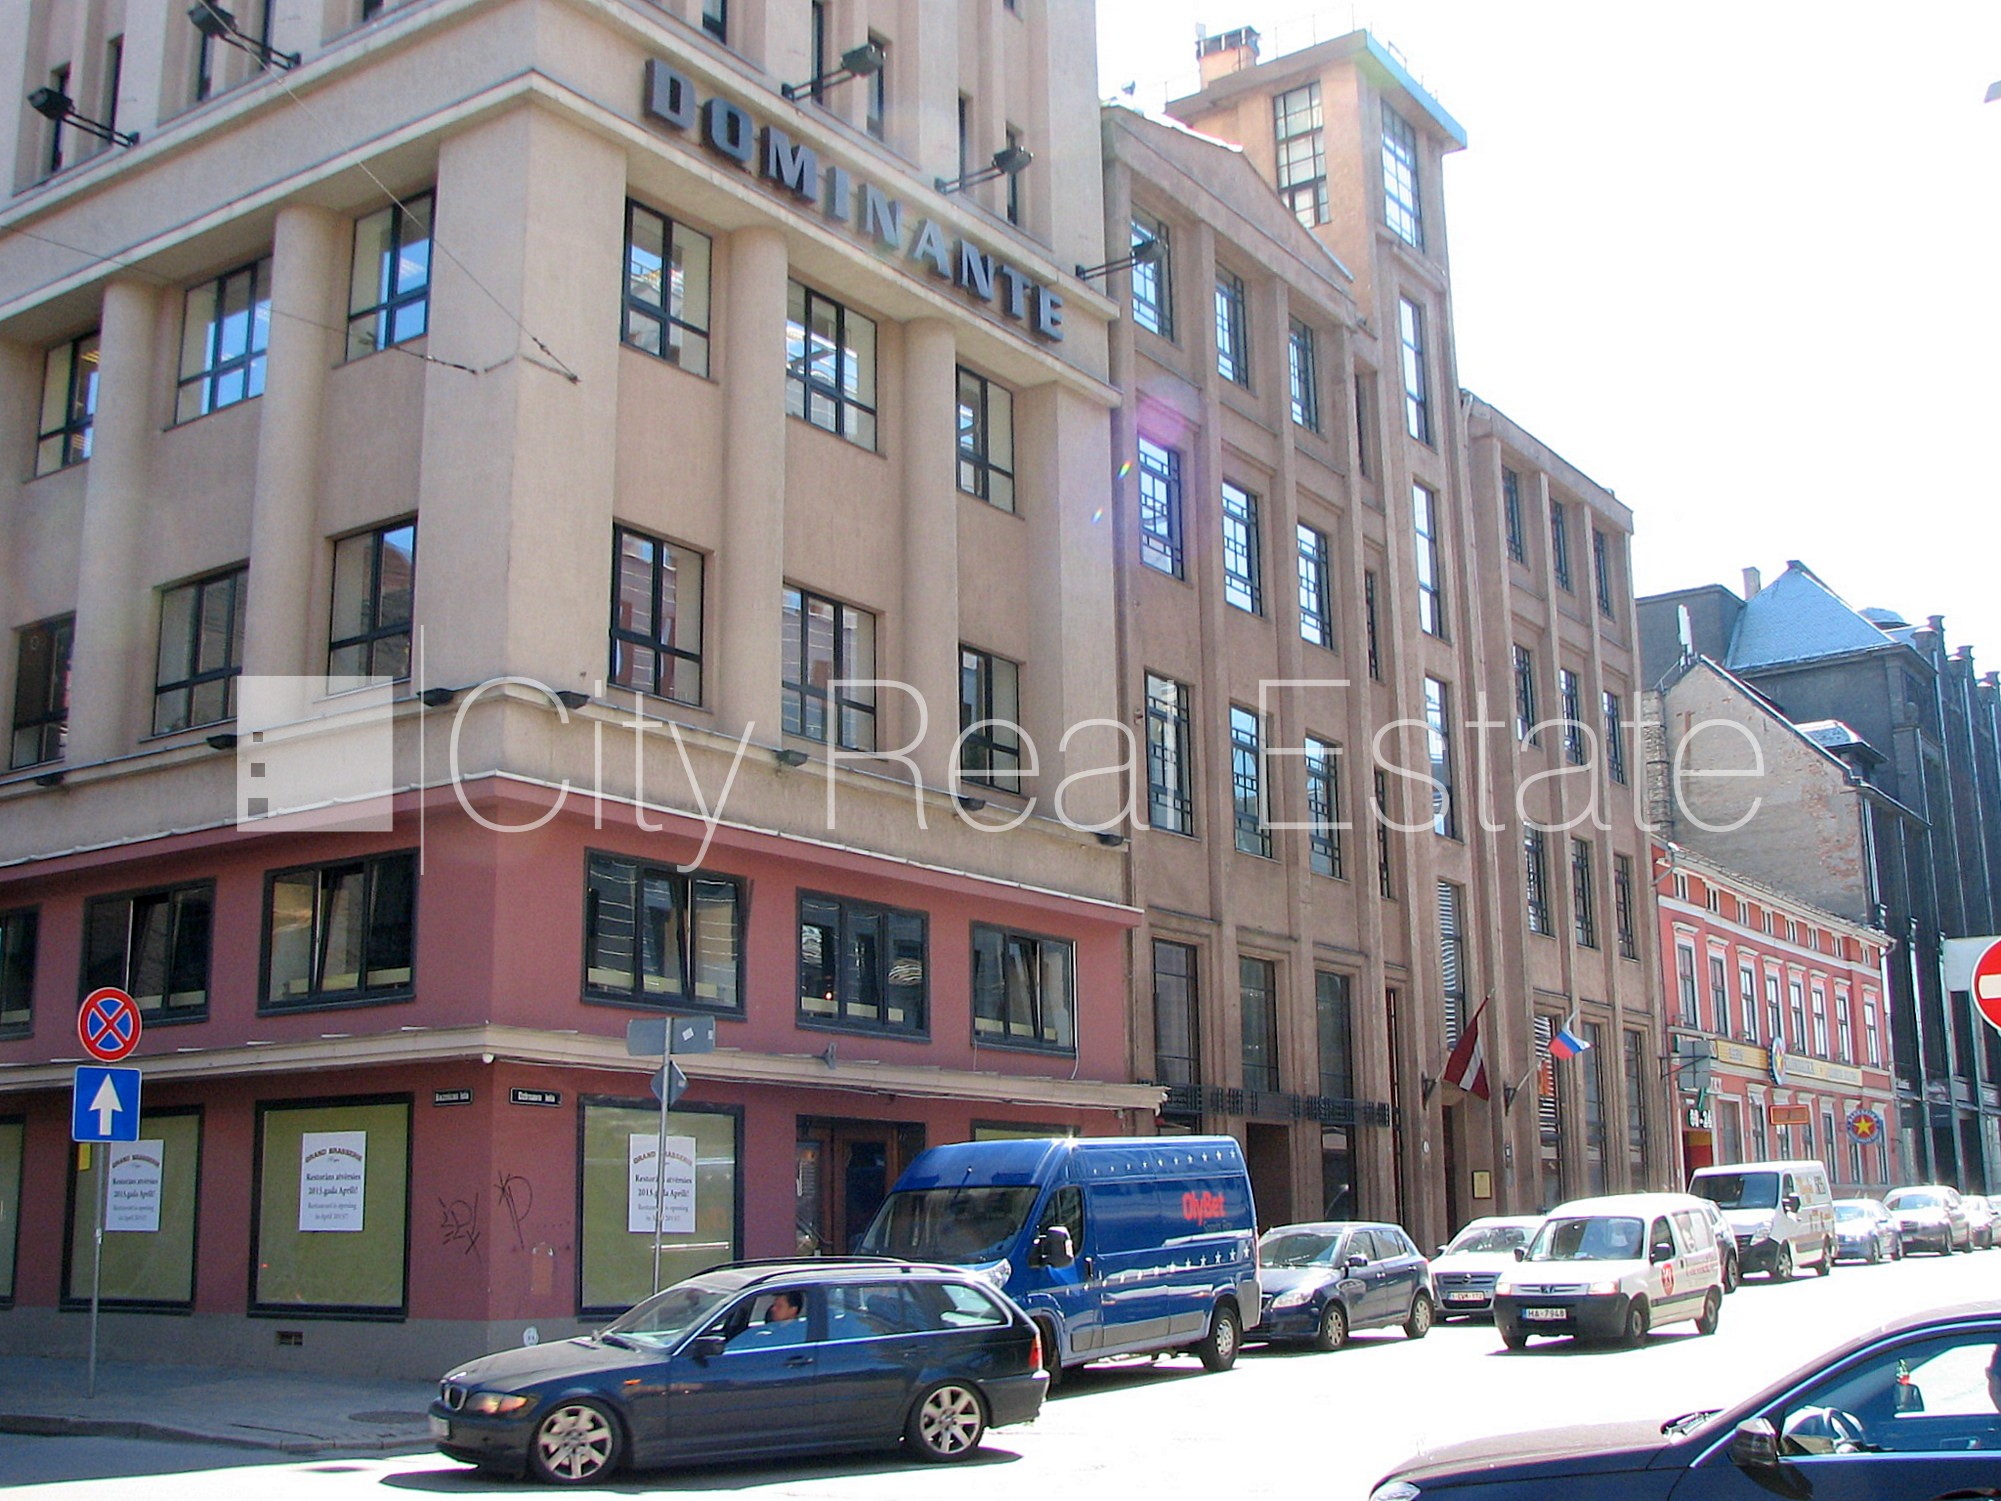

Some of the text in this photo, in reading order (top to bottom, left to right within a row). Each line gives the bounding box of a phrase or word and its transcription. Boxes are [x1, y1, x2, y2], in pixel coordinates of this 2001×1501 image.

[645, 58, 1064, 342] DOMINANTE
[305, 1149, 327, 1163] GRAND
[633, 1151, 656, 1165] GRAND
[1182, 1191, 1226, 1226] OlyBet
